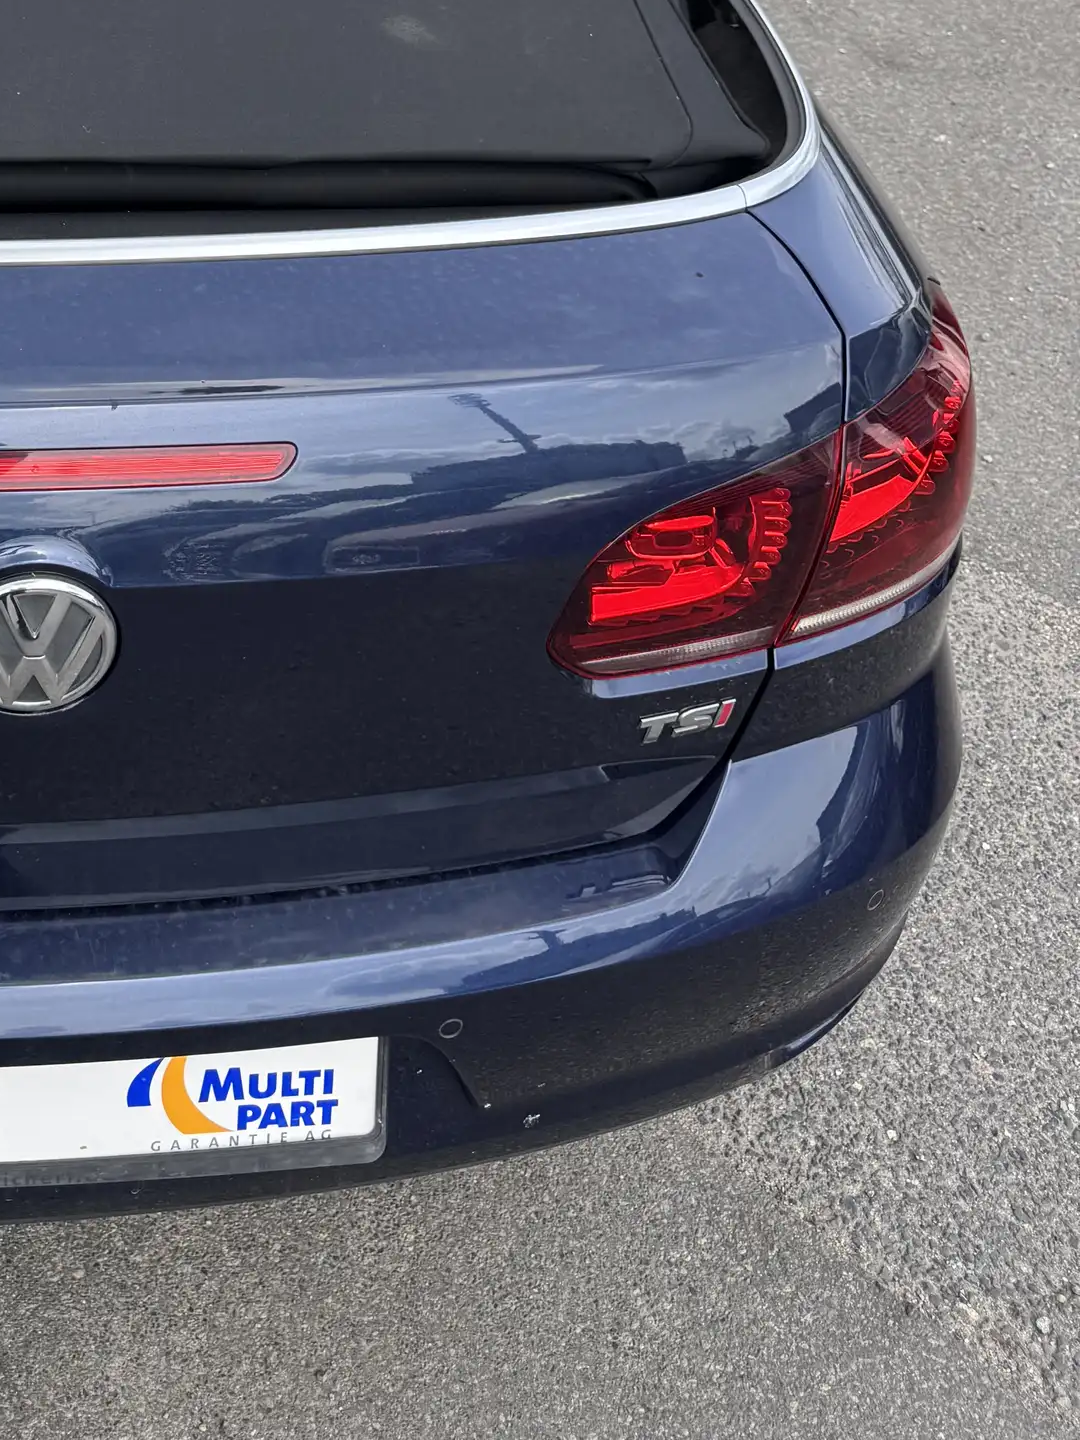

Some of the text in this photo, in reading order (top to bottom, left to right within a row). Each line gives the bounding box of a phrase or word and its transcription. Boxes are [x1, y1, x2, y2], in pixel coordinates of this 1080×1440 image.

[198, 1067, 335, 1103] MULTI
[236, 1099, 339, 1132] PART
[150, 1128, 332, 1152] GARANTIE AG
